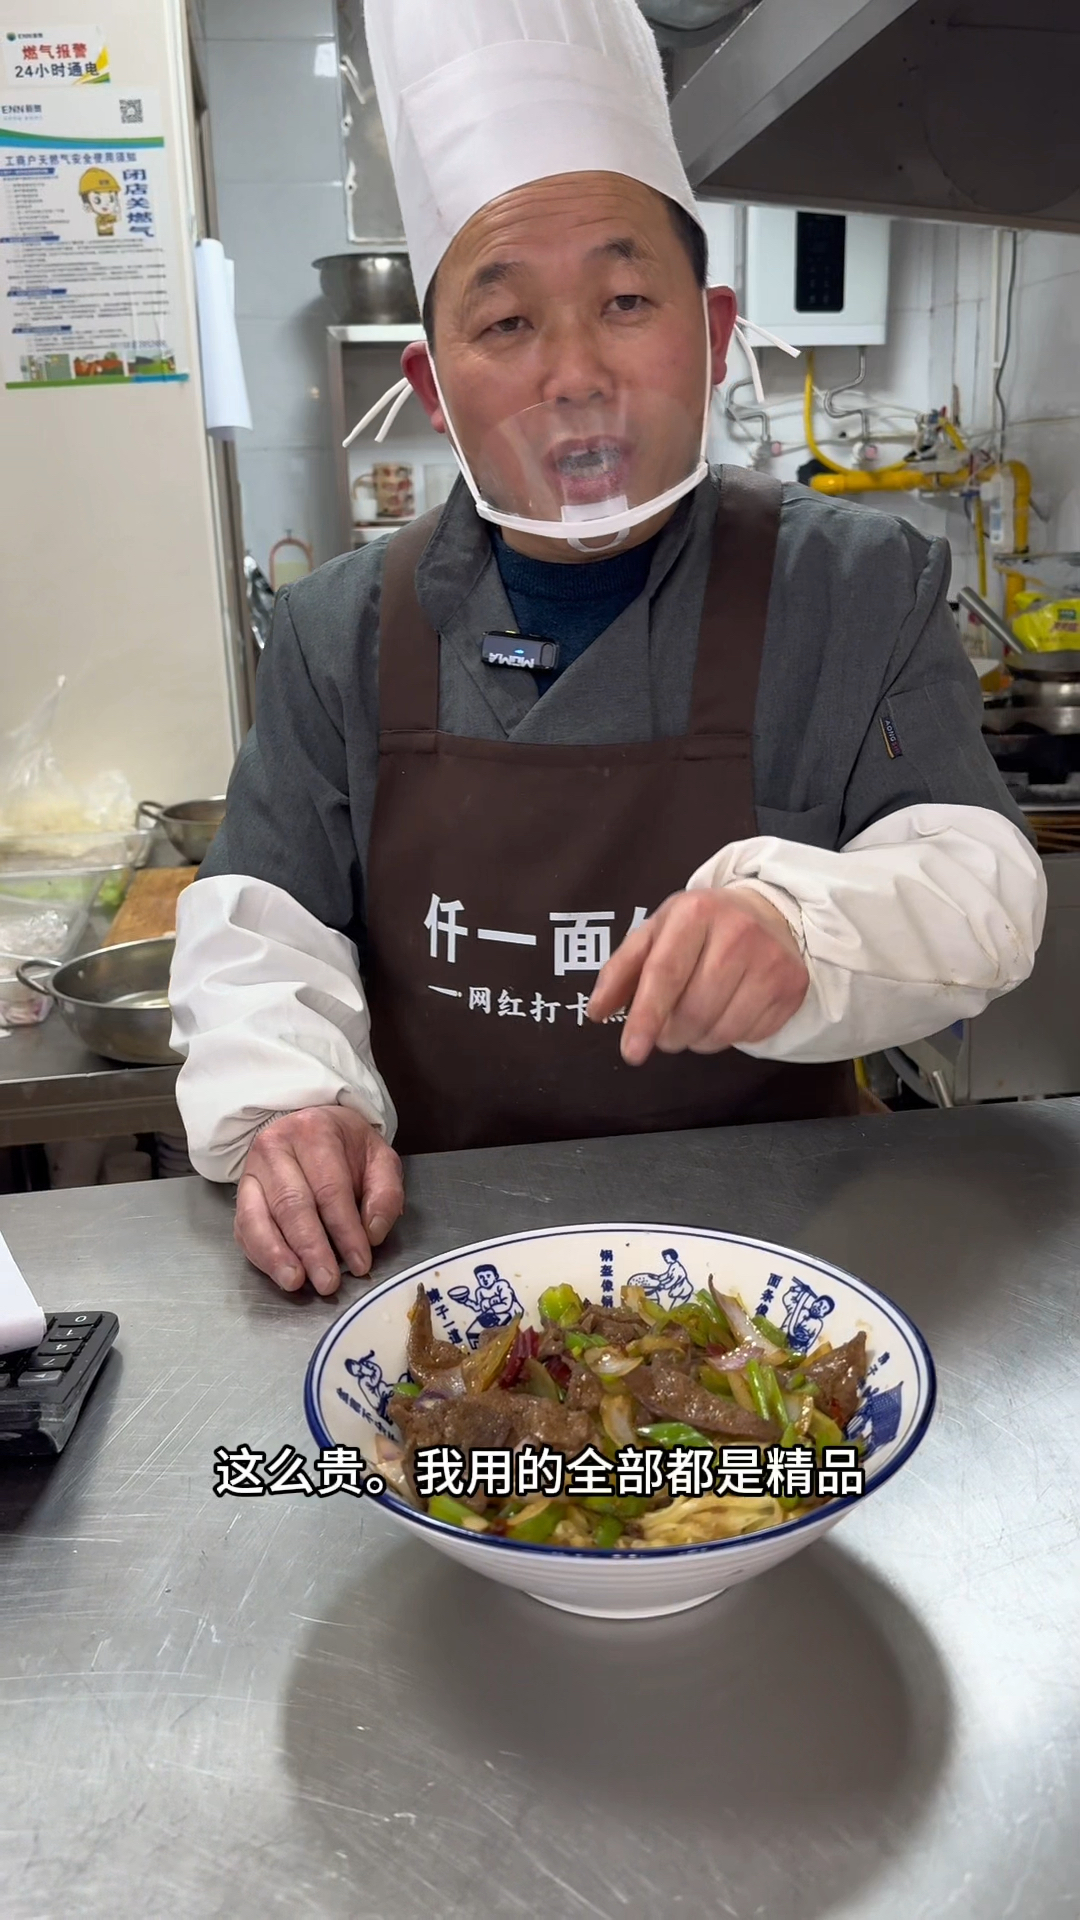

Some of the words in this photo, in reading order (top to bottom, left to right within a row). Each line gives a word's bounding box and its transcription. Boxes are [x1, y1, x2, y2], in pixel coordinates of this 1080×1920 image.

[15, 62, 100, 78] 24小时通电
[22, 43, 87, 60] 燃气报警
[122, 169, 154, 237] 闭店关燃气
[424, 893, 648, 976] 仟一面
